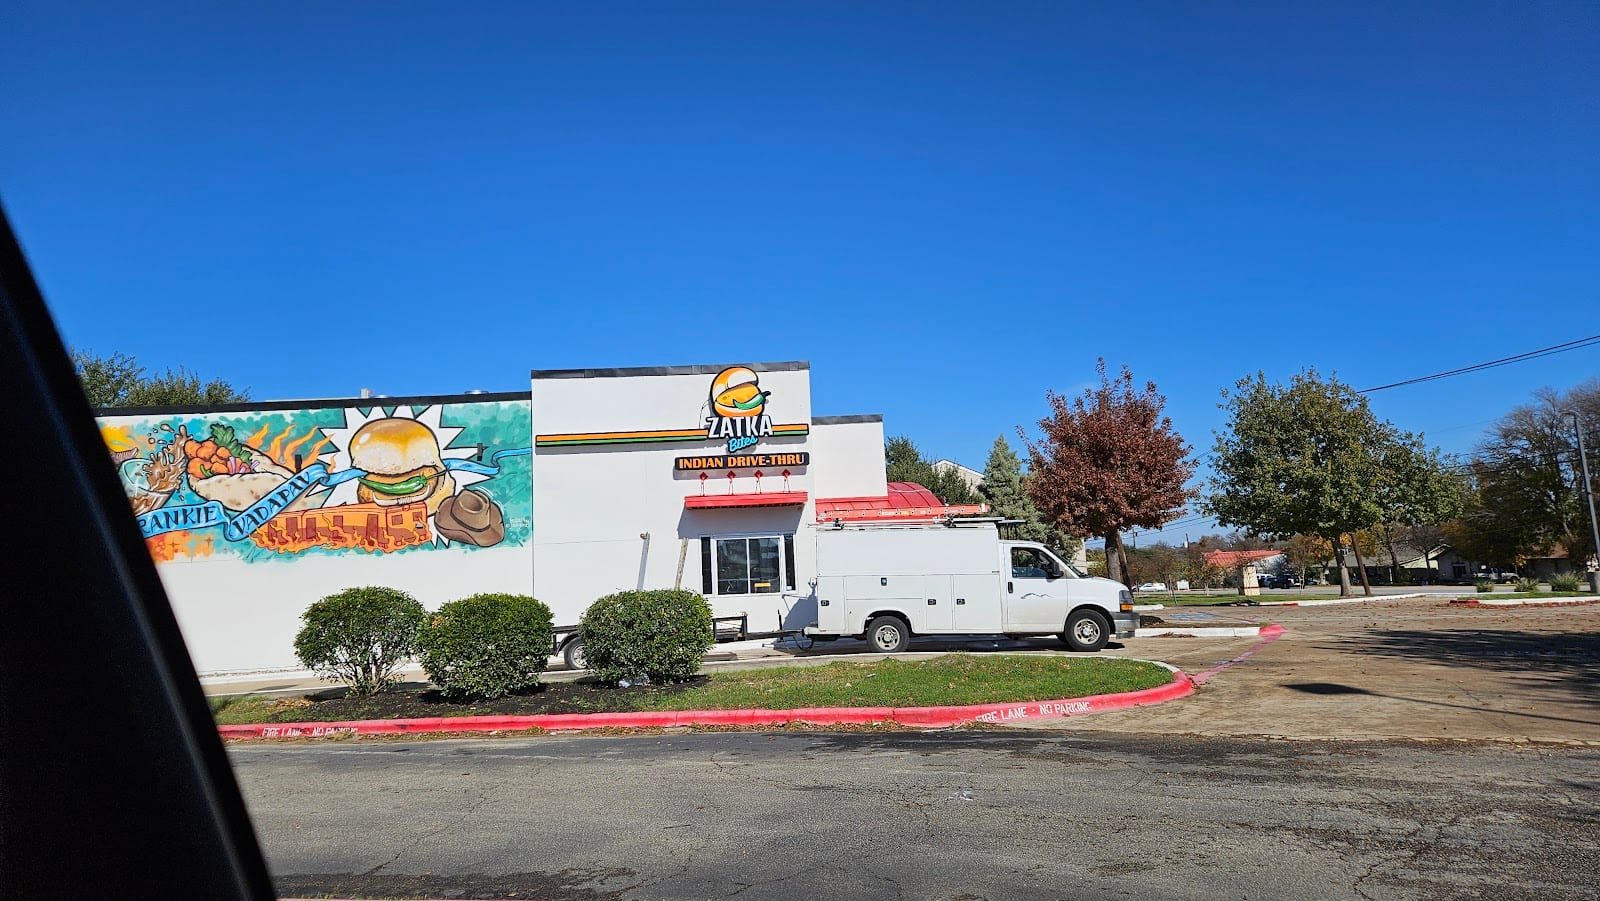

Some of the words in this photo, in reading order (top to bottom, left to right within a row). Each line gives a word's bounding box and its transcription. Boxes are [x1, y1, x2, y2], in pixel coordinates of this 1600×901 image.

[707, 415, 774, 438] ZATKA
[728, 435, 758, 452] Bites
[679, 458, 723, 469] INDIAN
[727, 454, 805, 468] DRIVE-THRU
[137, 505, 216, 534] RANKIE
[975, 711, 997, 722] FIRE
[1000, 706, 1028, 720] LANE
[1038, 703, 1054, 715] NO
[1053, 701, 1092, 714] PARKING
[262, 727, 280, 737] FIRE
[311, 725, 324, 736] NO
